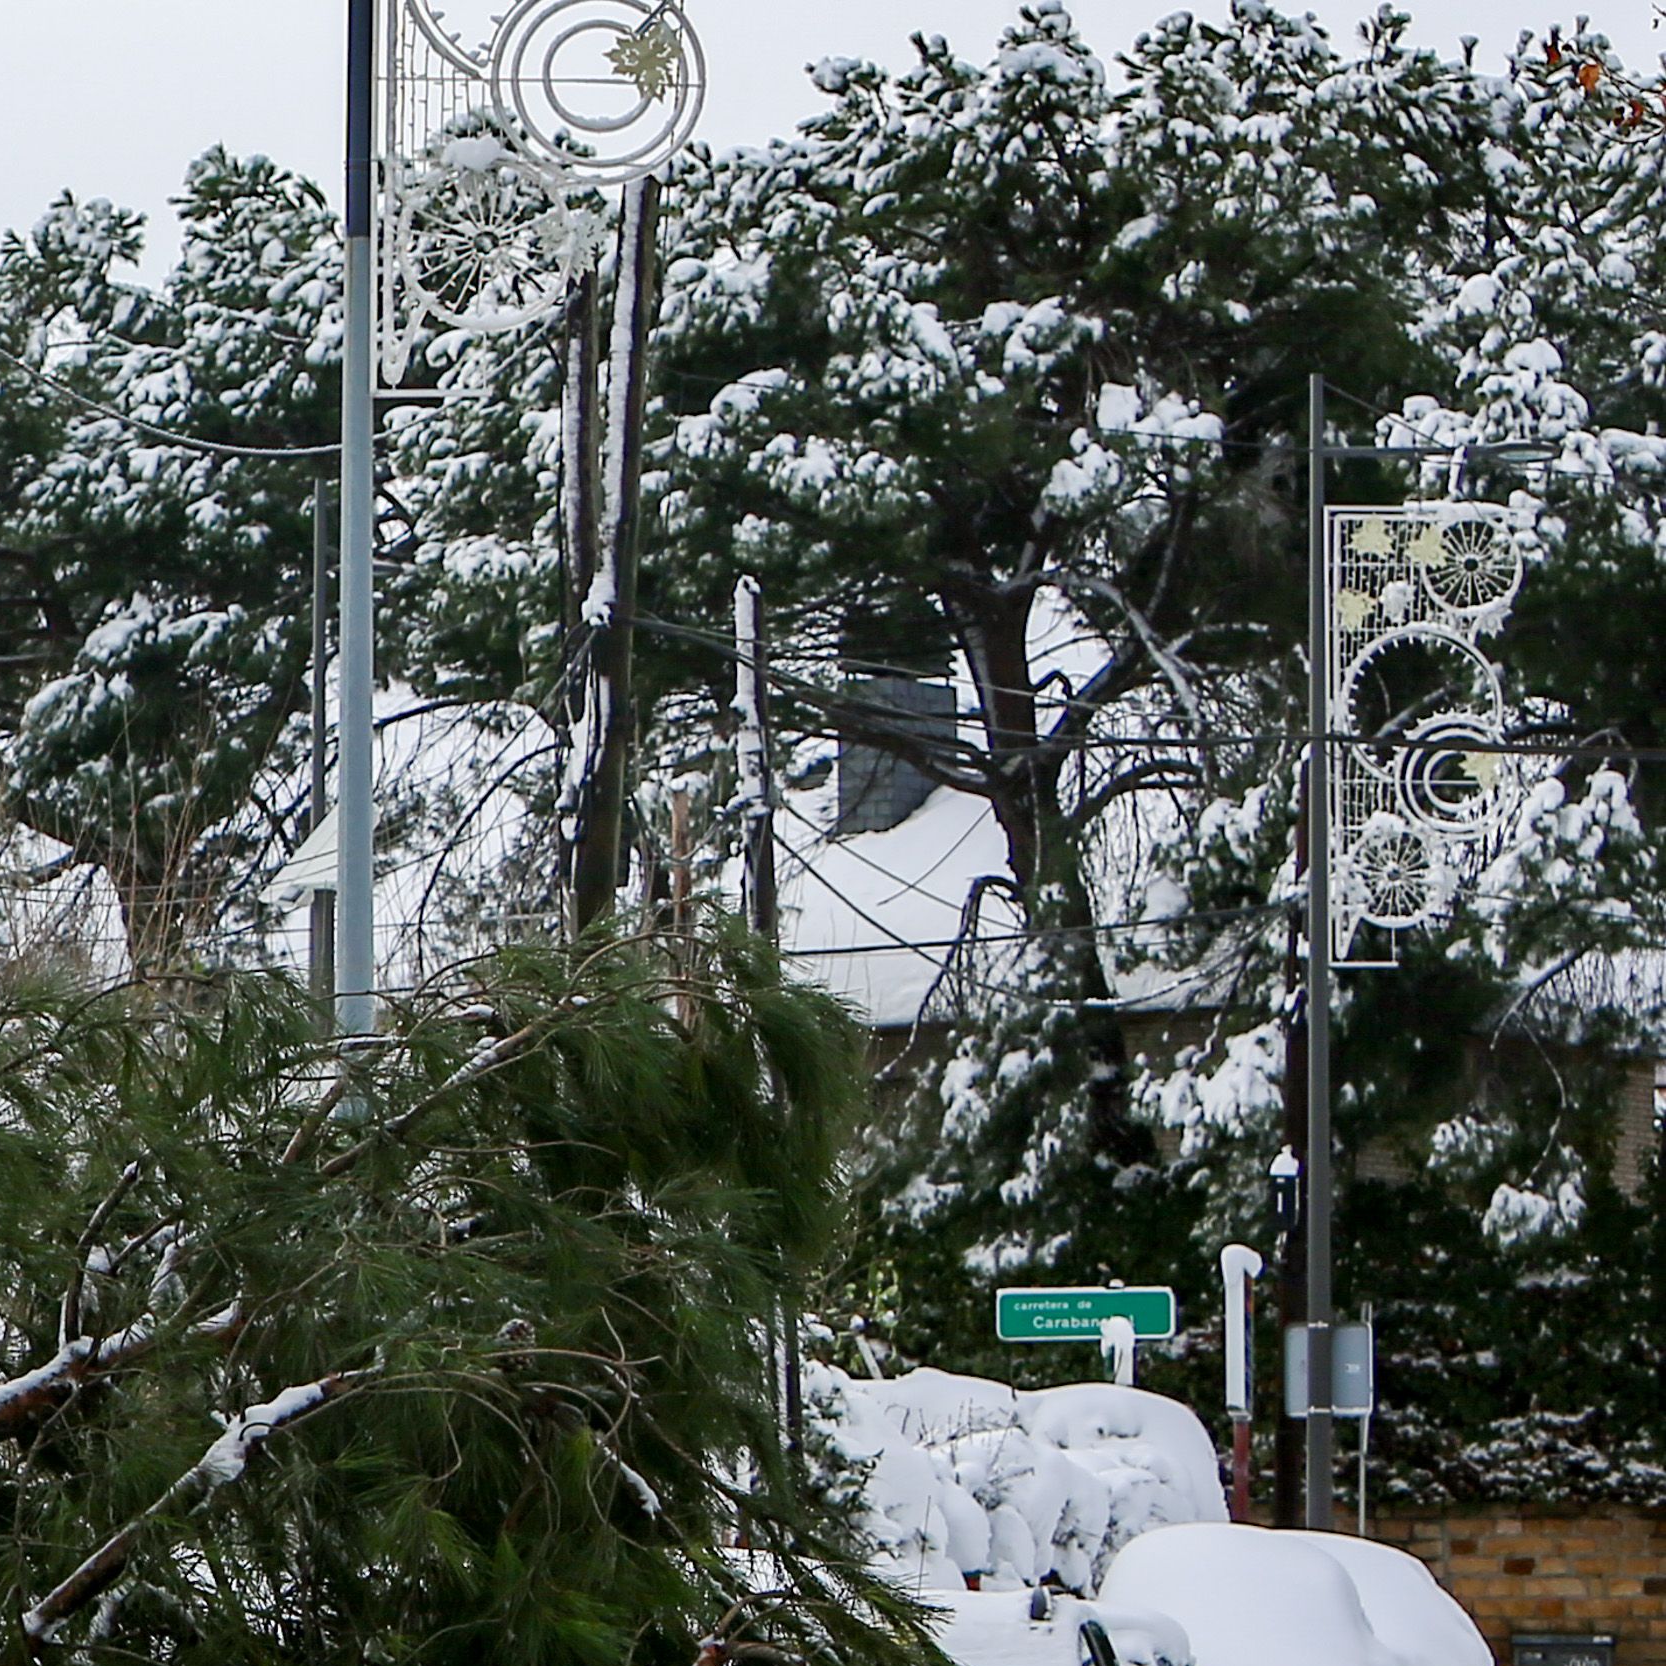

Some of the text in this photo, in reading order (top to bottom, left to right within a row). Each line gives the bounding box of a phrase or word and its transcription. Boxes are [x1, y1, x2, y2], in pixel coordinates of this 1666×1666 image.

[1014, 1300, 1092, 1311] carretera de
[1033, 1314, 1134, 1329] Carabanl
